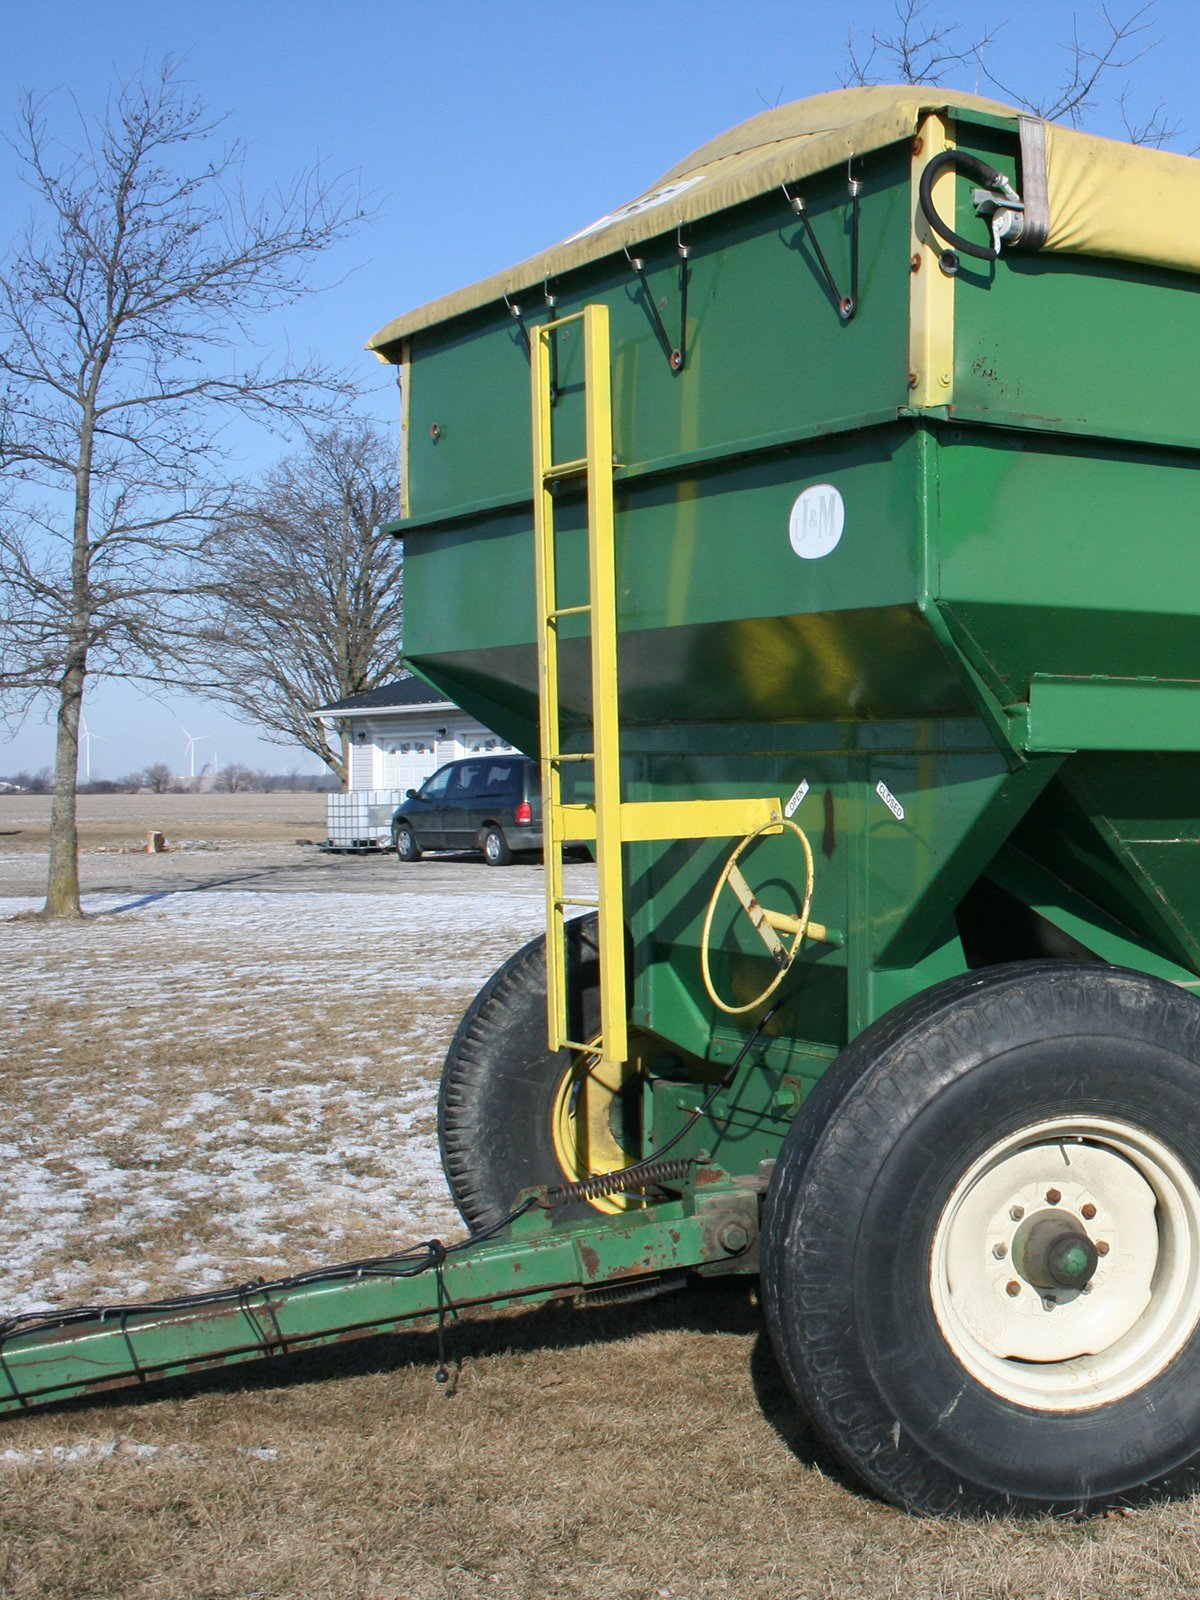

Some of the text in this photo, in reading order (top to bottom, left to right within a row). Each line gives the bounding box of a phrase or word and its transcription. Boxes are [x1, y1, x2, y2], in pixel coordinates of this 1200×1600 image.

[794, 492, 837, 542] J&M
[789, 788, 805, 811] OPEN
[878, 784, 902, 817] CLOSED
